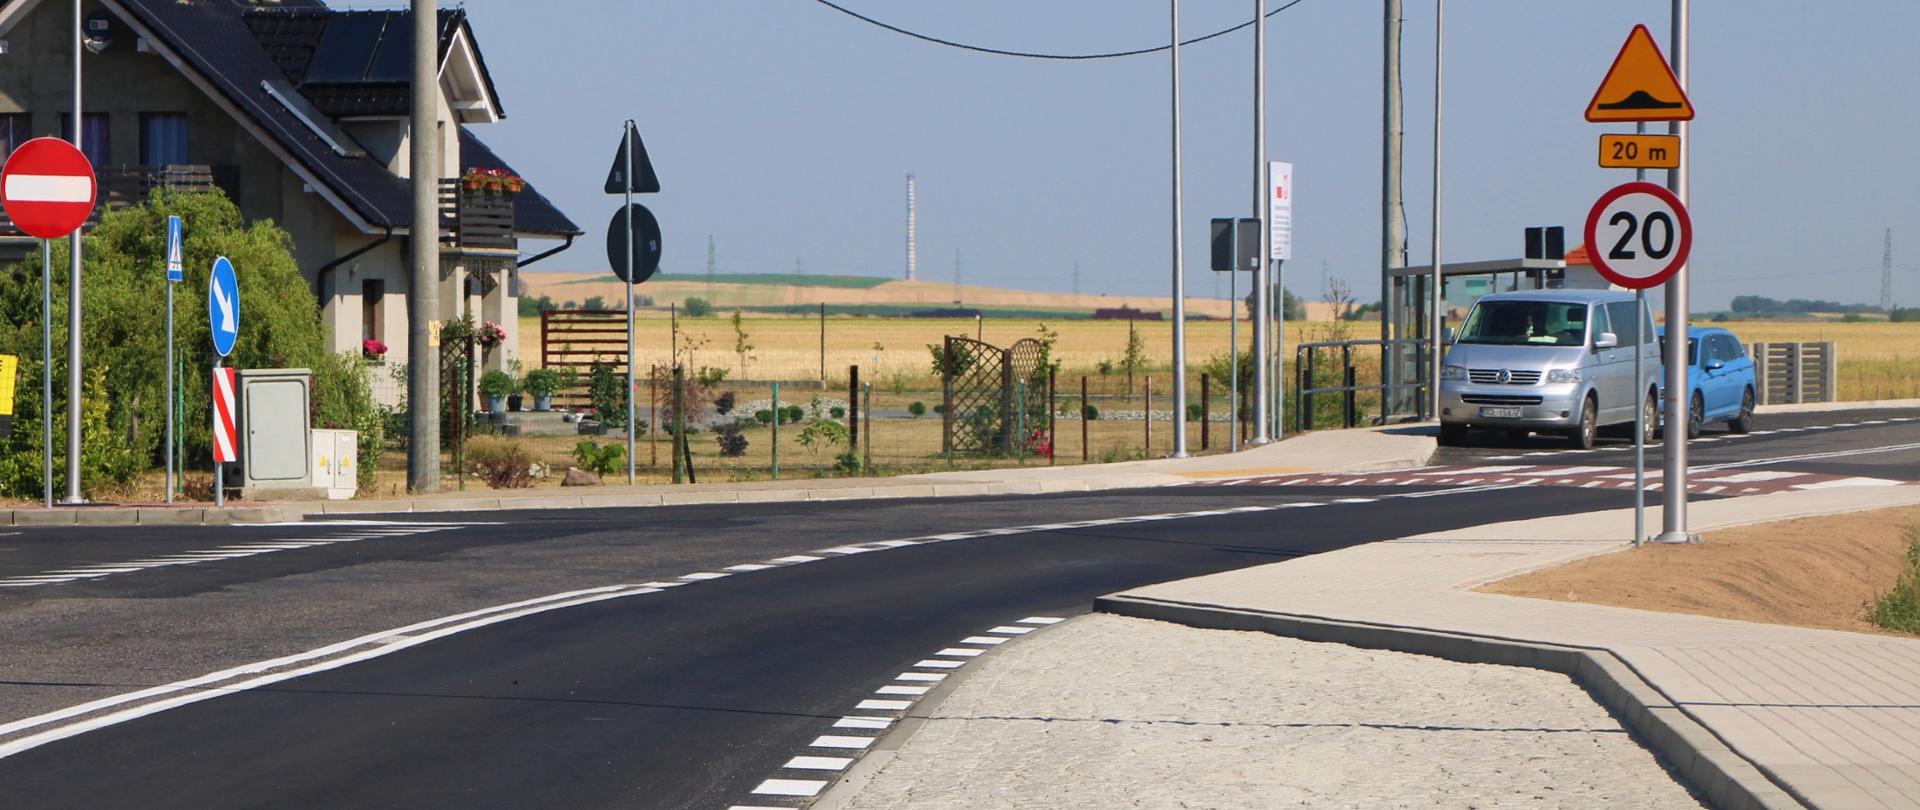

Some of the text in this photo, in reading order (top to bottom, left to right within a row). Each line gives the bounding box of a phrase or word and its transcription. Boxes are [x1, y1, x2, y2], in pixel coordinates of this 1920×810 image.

[1612, 141, 1667, 161] 20 m
[1608, 210, 1675, 260] 20
